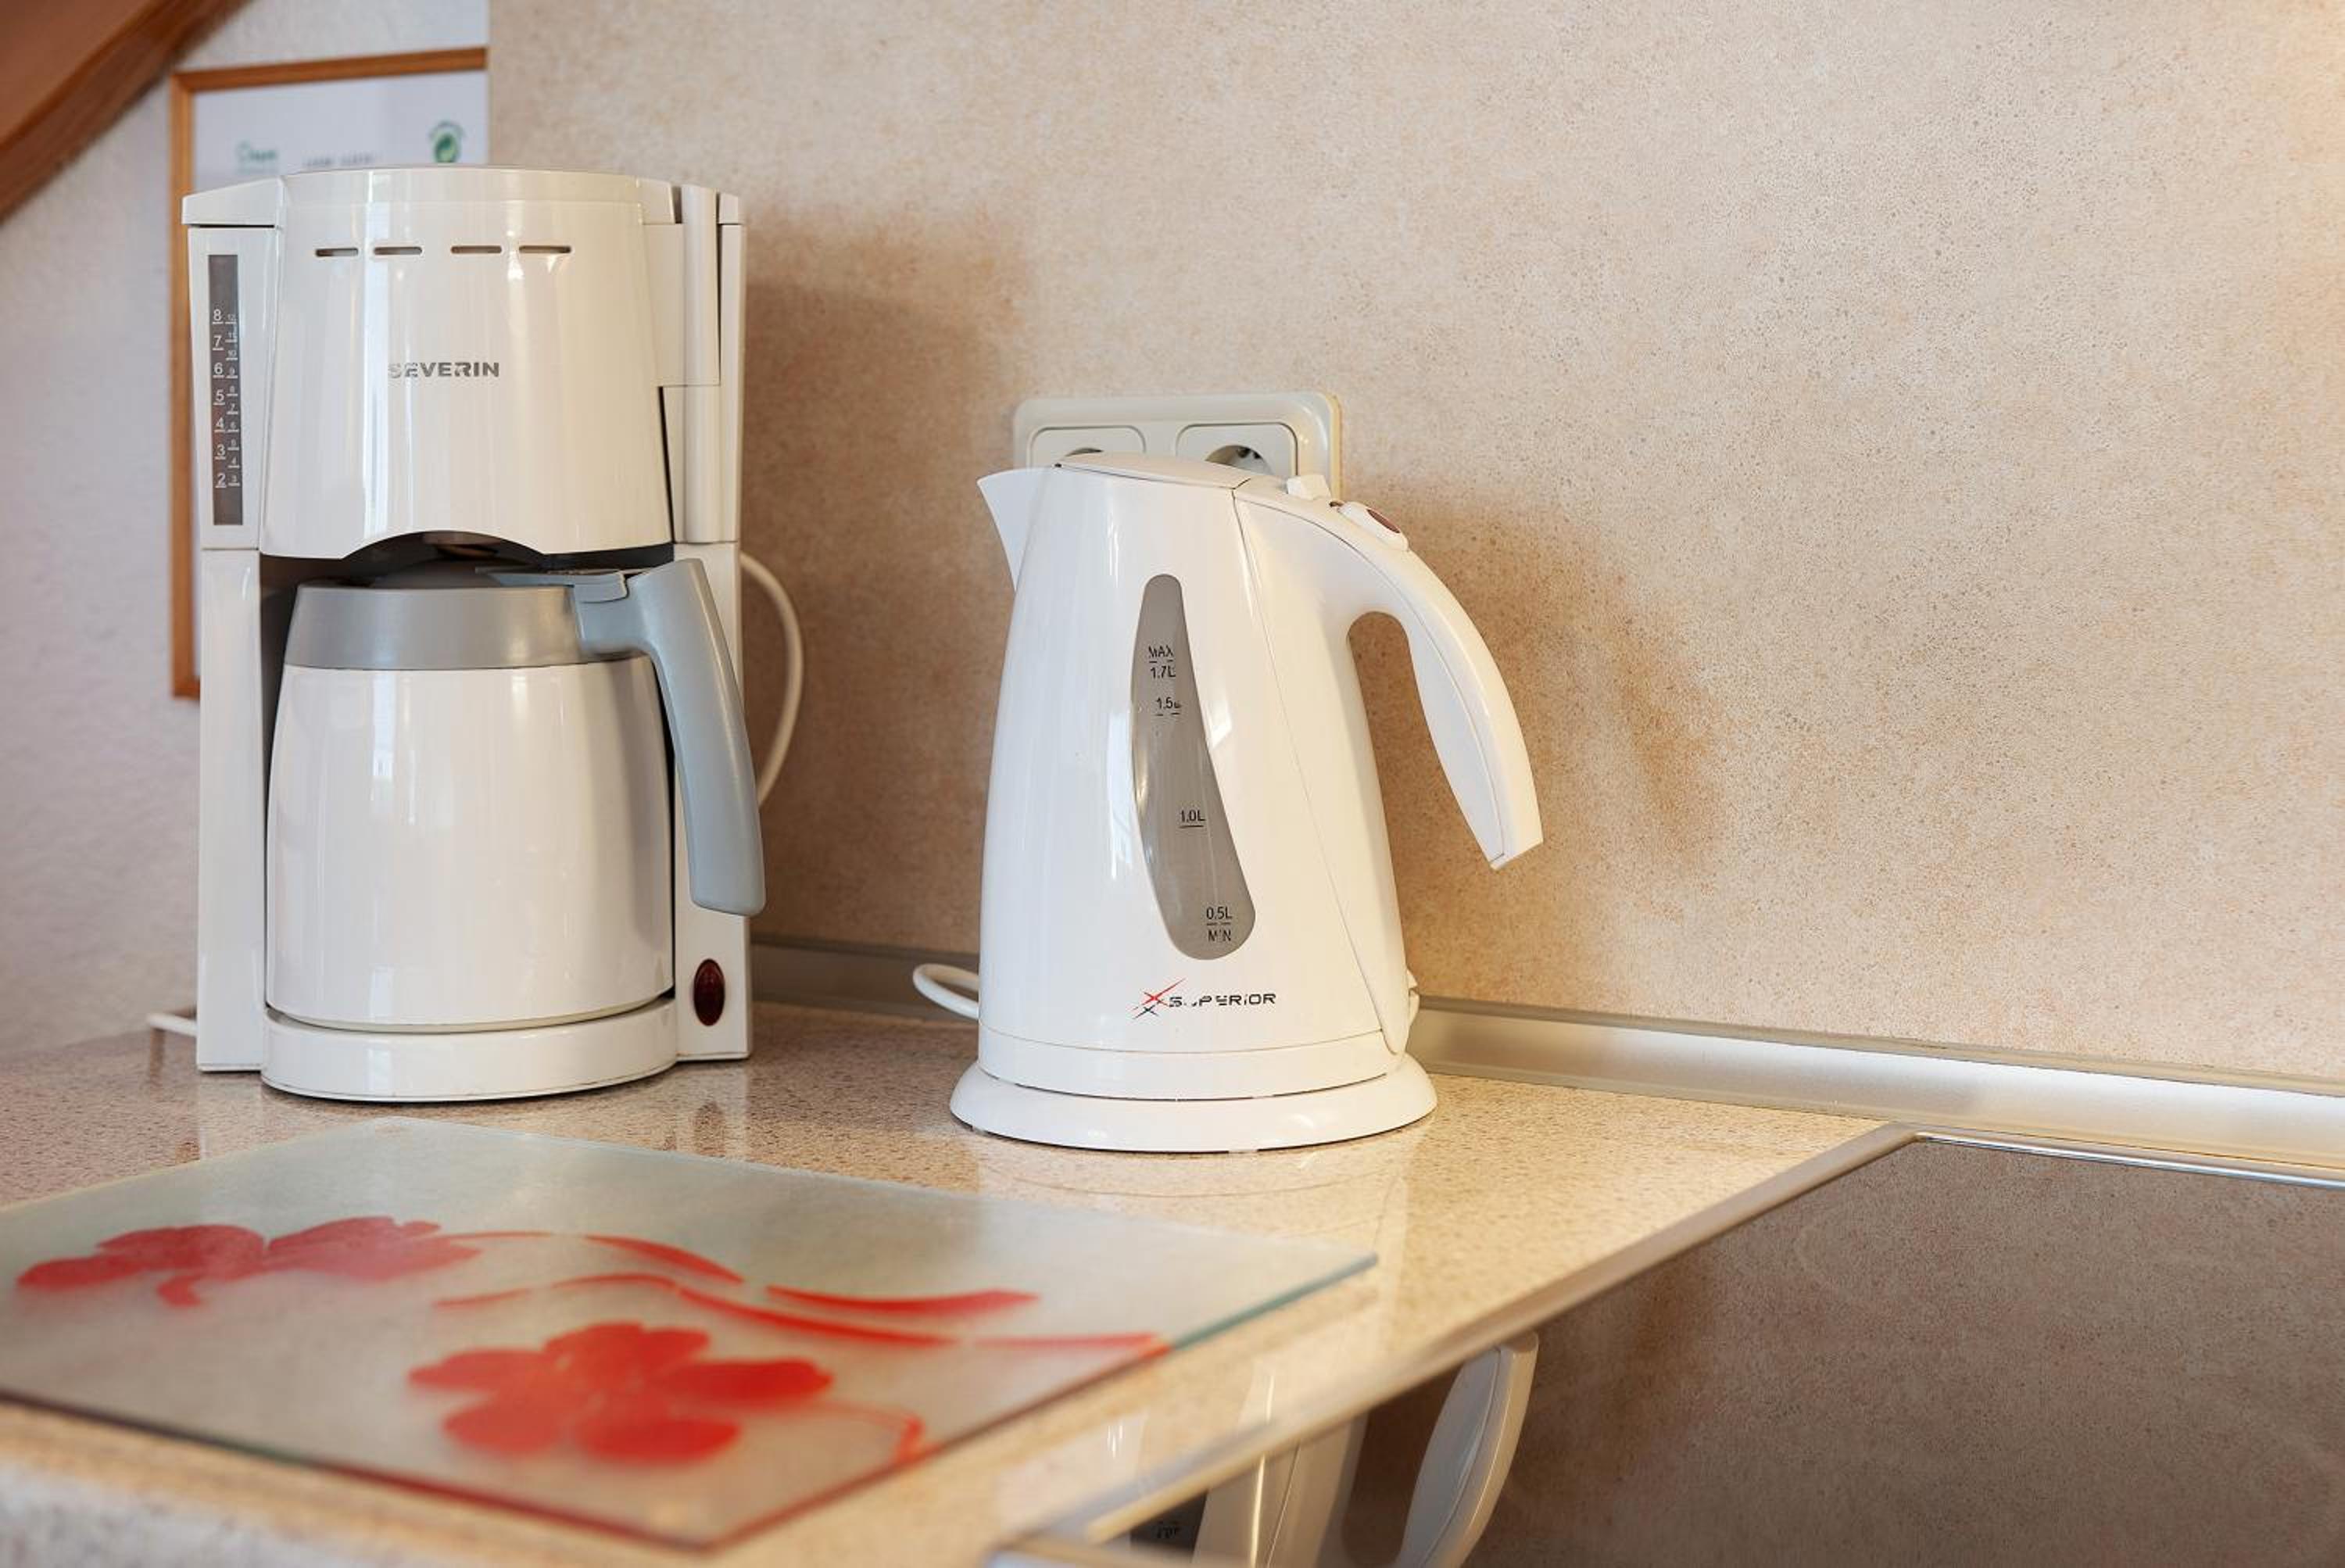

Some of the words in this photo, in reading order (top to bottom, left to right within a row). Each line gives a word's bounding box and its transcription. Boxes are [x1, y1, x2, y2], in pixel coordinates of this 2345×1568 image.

[213, 309, 222, 320] 8
[213, 335, 222, 347] 7
[214, 363, 223, 374] 6
[388, 362, 499, 378] SEVERIN
[216, 389, 224, 402] 5
[216, 417, 224, 428] 4
[217, 443, 225, 456] 3
[217, 473, 226, 485] 2
[1148, 645, 1173, 657] MAX
[1150, 665, 1176, 678] 1.7L
[1179, 810, 1206, 823] 1.0L
[1205, 906, 1233, 920] 0.5L
